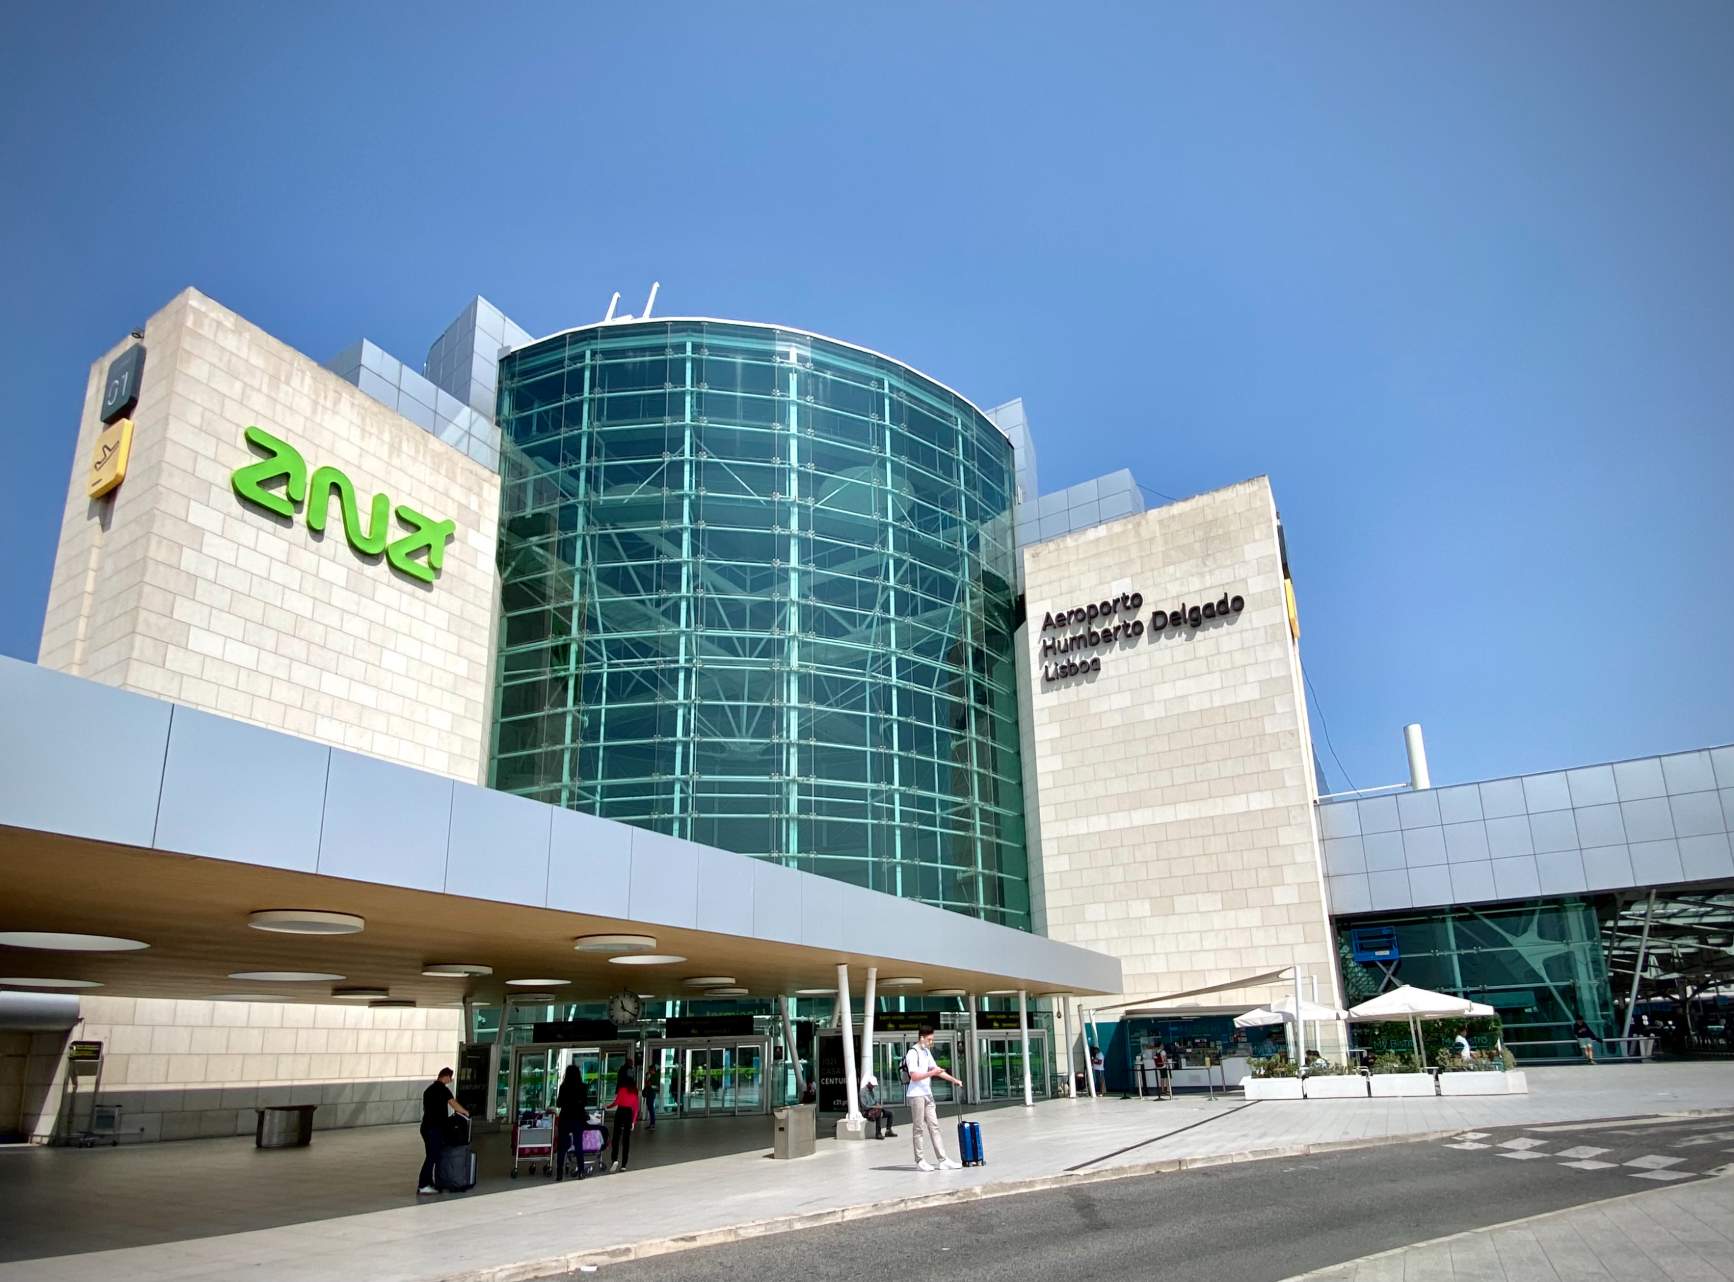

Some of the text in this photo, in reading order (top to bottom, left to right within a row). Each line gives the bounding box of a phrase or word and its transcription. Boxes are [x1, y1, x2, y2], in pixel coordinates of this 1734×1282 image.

[107, 371, 129, 406] 01
[1042, 592, 1144, 632] Aeroporto
[1042, 592, 1245, 658] Humberto Delgado
[1044, 656, 1101, 682] Lisboa
